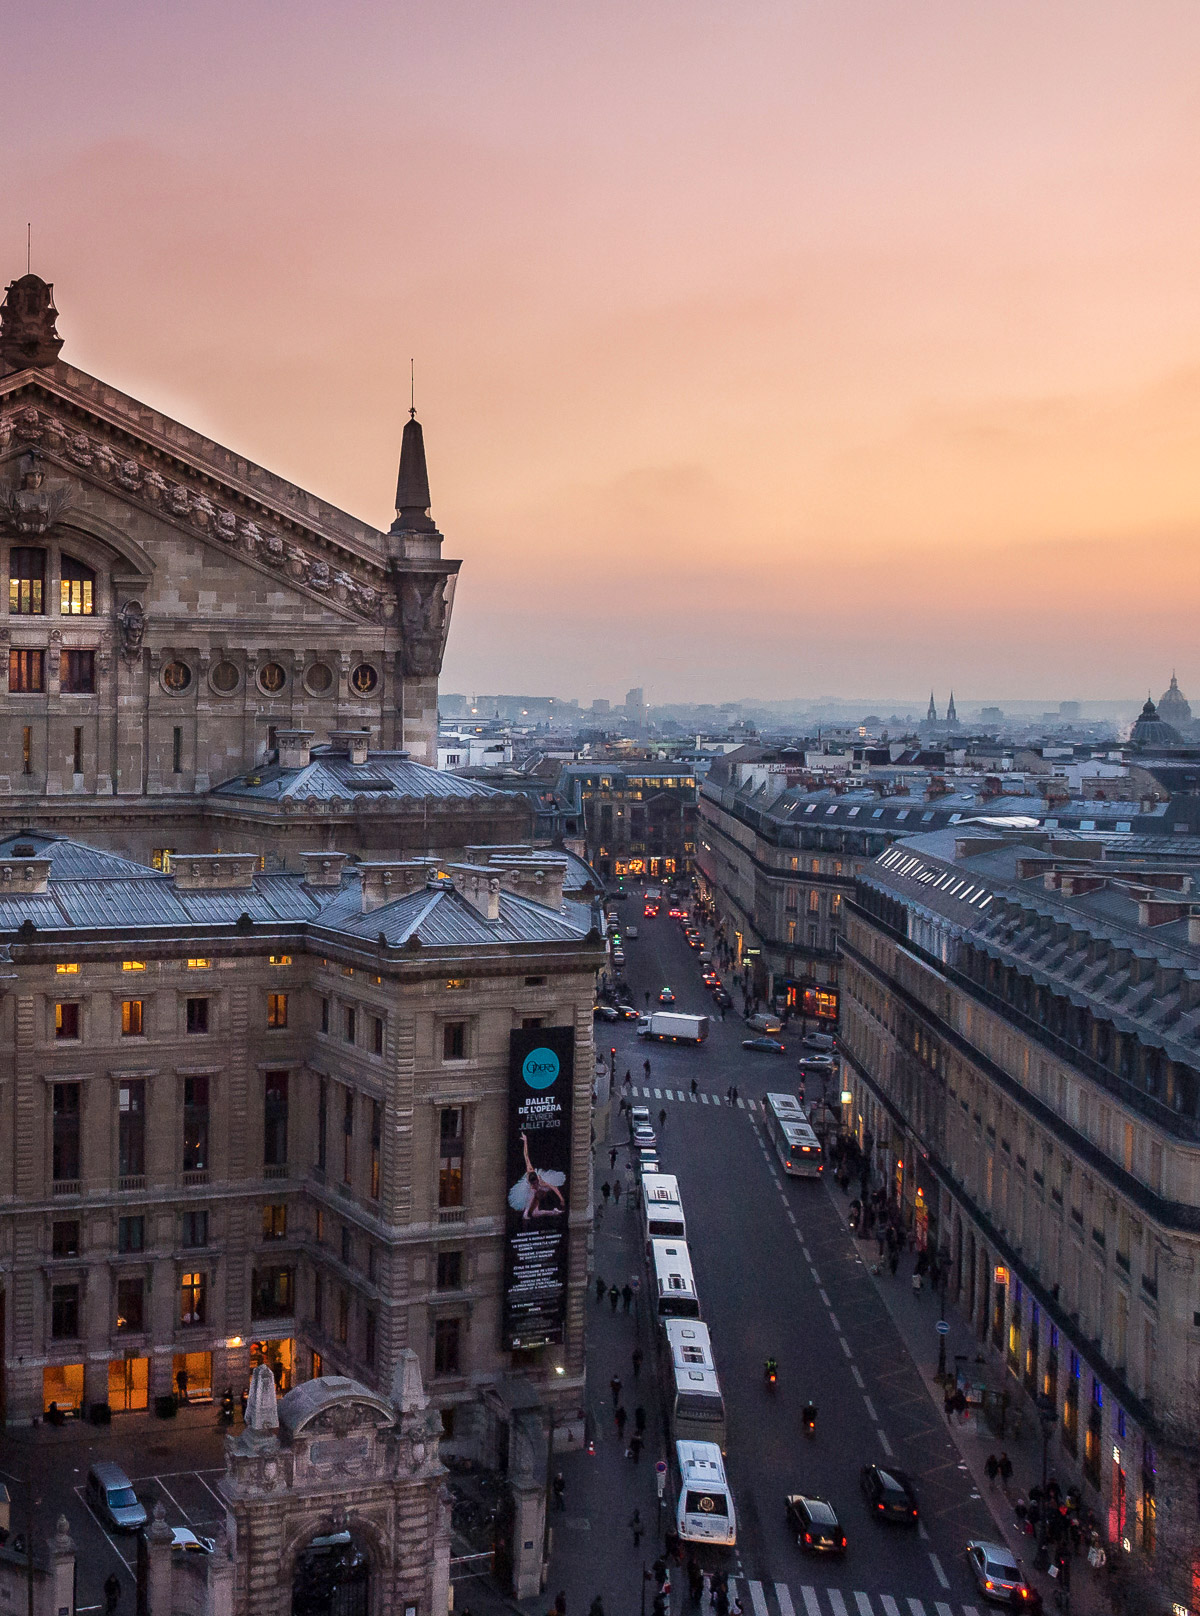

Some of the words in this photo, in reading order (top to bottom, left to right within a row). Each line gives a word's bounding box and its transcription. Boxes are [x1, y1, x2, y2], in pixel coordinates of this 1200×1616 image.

[525, 1096, 556, 1106] BALLET
[518, 1106, 529, 1115] DE
[545, 1119, 561, 1128] 2013
